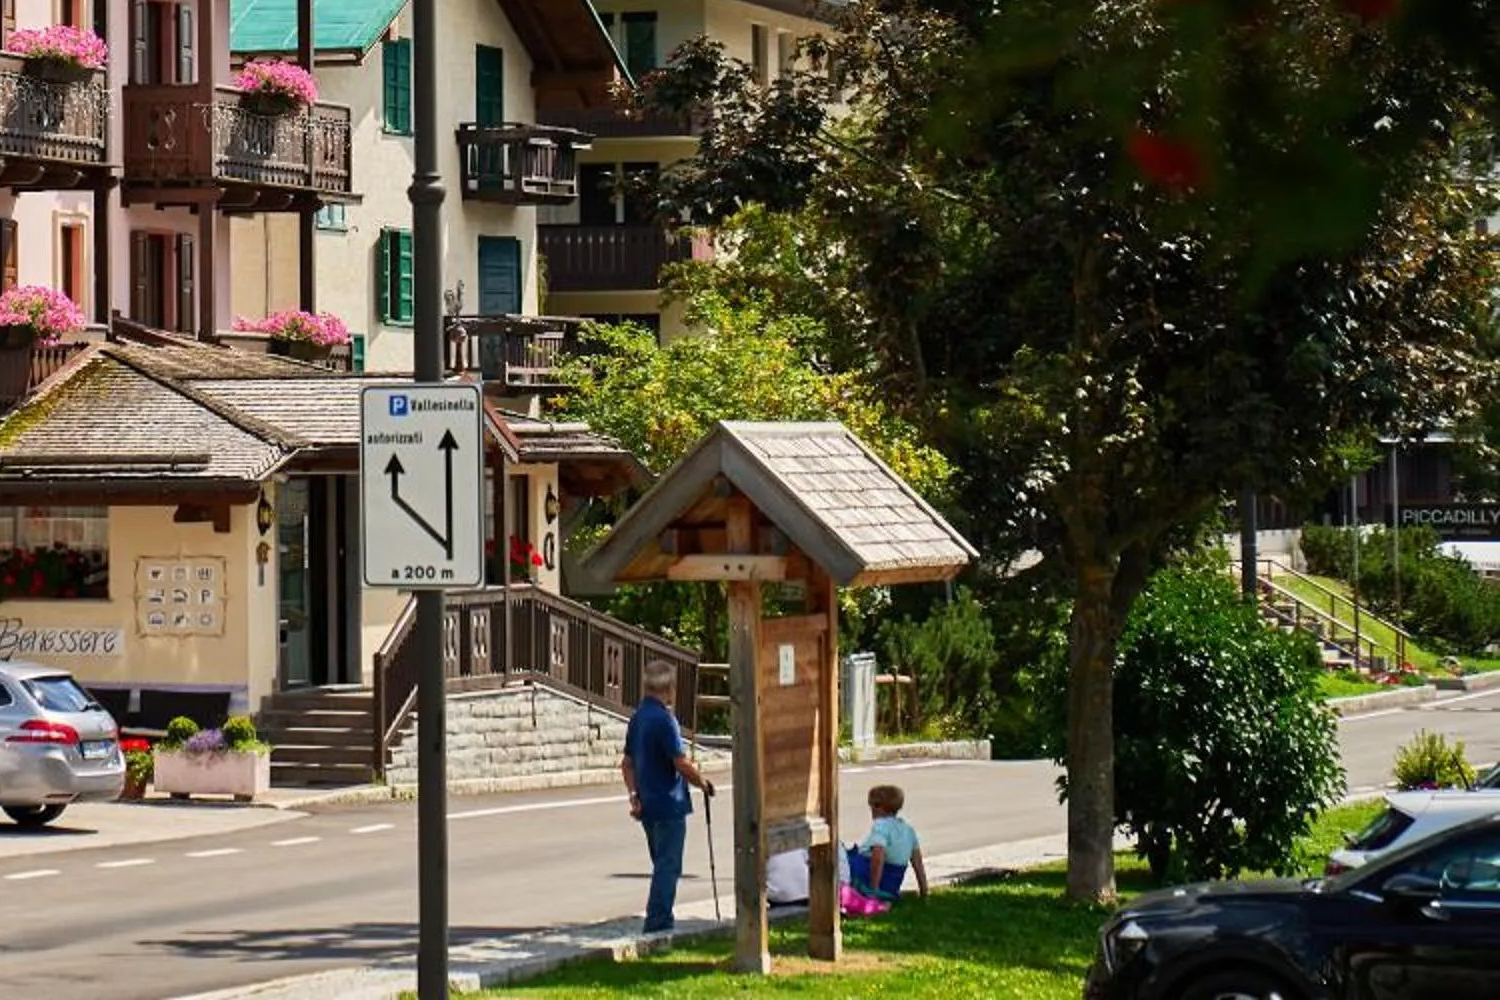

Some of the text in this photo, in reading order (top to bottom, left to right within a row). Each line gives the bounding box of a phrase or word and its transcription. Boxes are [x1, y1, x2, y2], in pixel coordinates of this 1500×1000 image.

[411, 399, 474, 412] Vallesinella
[367, 432, 423, 444] autorizzati
[1403, 509, 1500, 525] PICCADILLY
[391, 566, 454, 579] a 200 m
